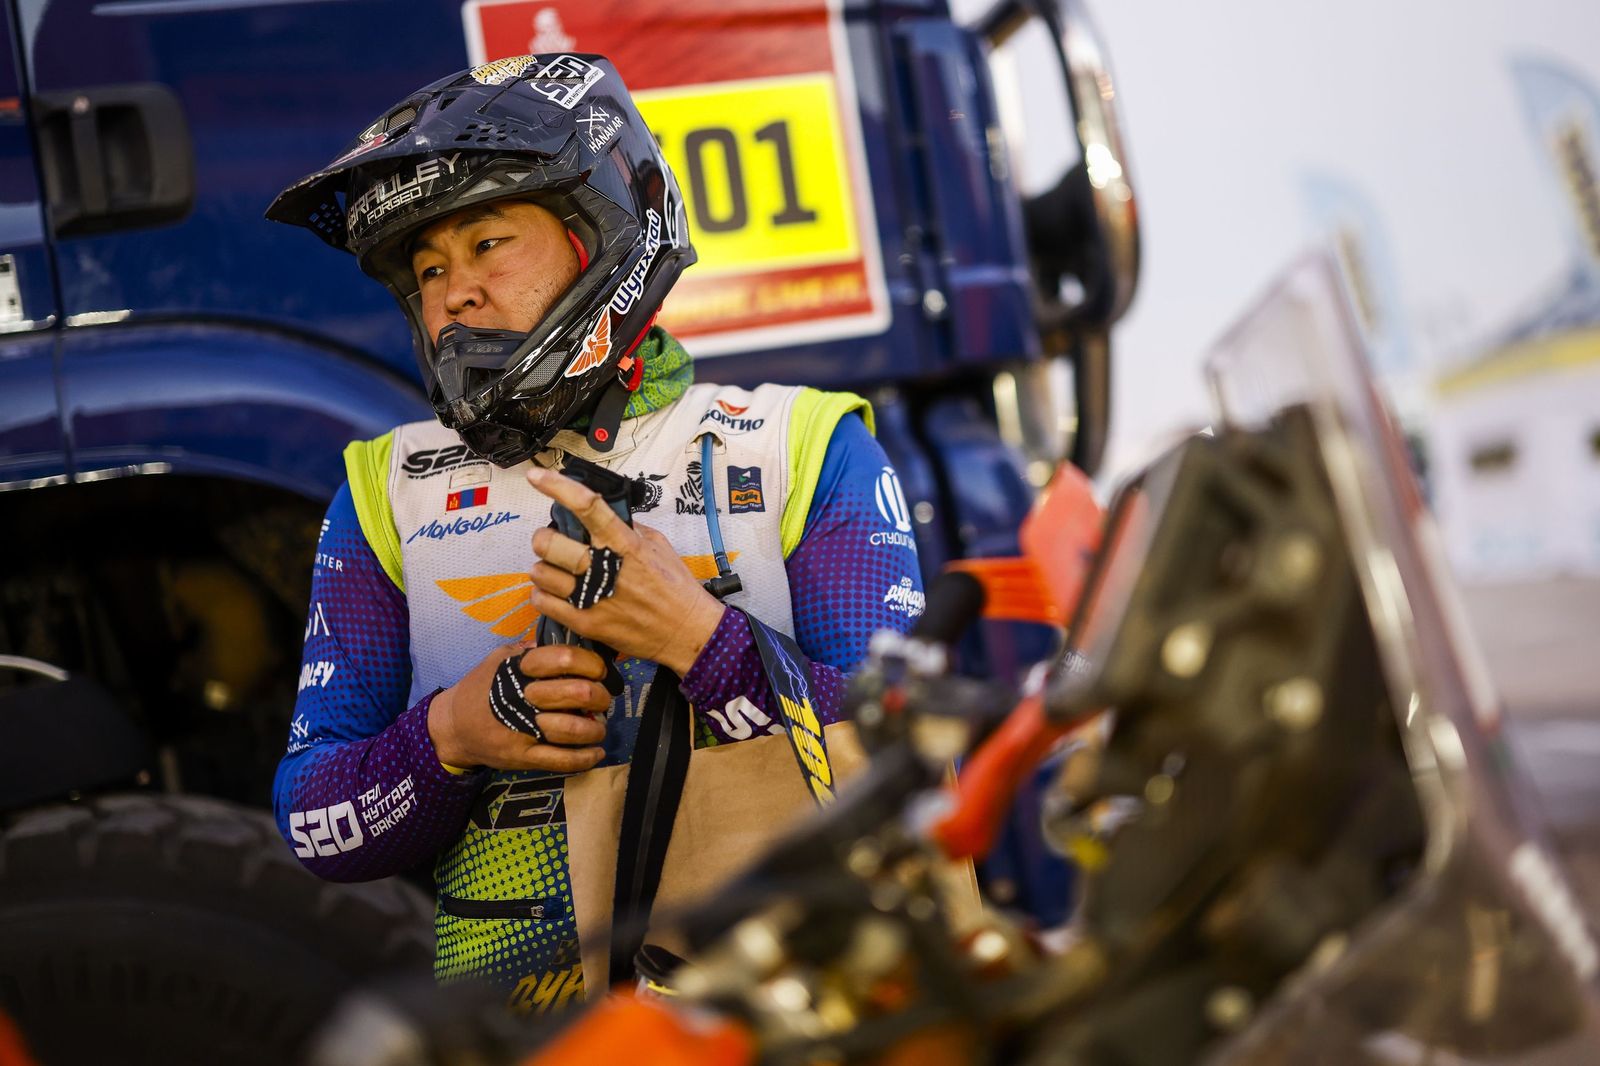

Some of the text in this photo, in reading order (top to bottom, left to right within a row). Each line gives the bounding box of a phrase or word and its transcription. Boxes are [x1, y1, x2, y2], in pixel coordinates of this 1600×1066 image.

[652, 119, 817, 233] 01
[366, 186, 423, 225] FORGED
[675, 498, 721, 516] DAKA
